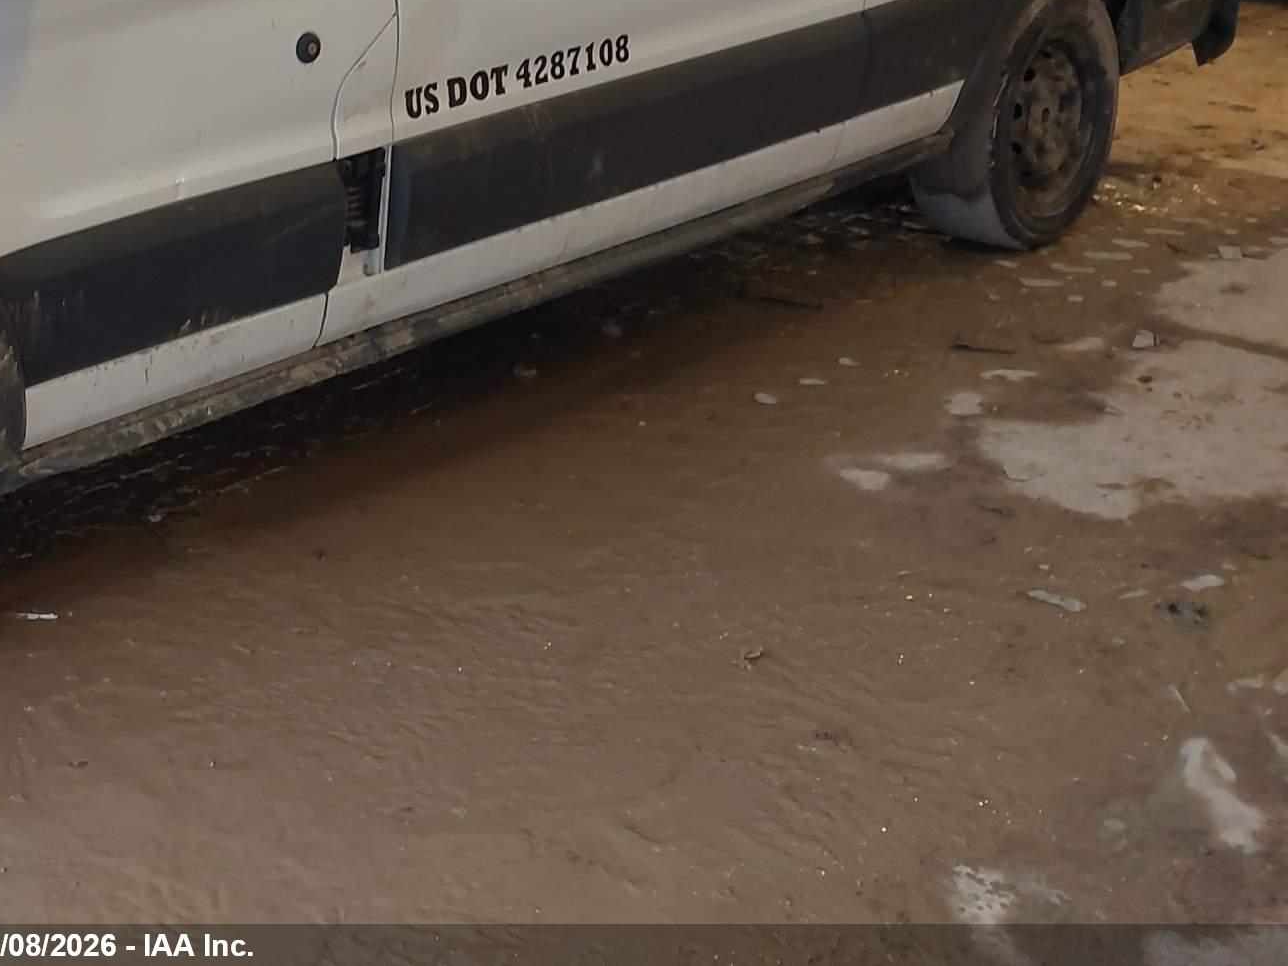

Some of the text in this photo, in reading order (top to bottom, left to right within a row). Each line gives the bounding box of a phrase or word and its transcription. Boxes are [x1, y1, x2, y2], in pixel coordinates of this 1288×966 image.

[405, 33, 630, 119] US DOT 4287108
